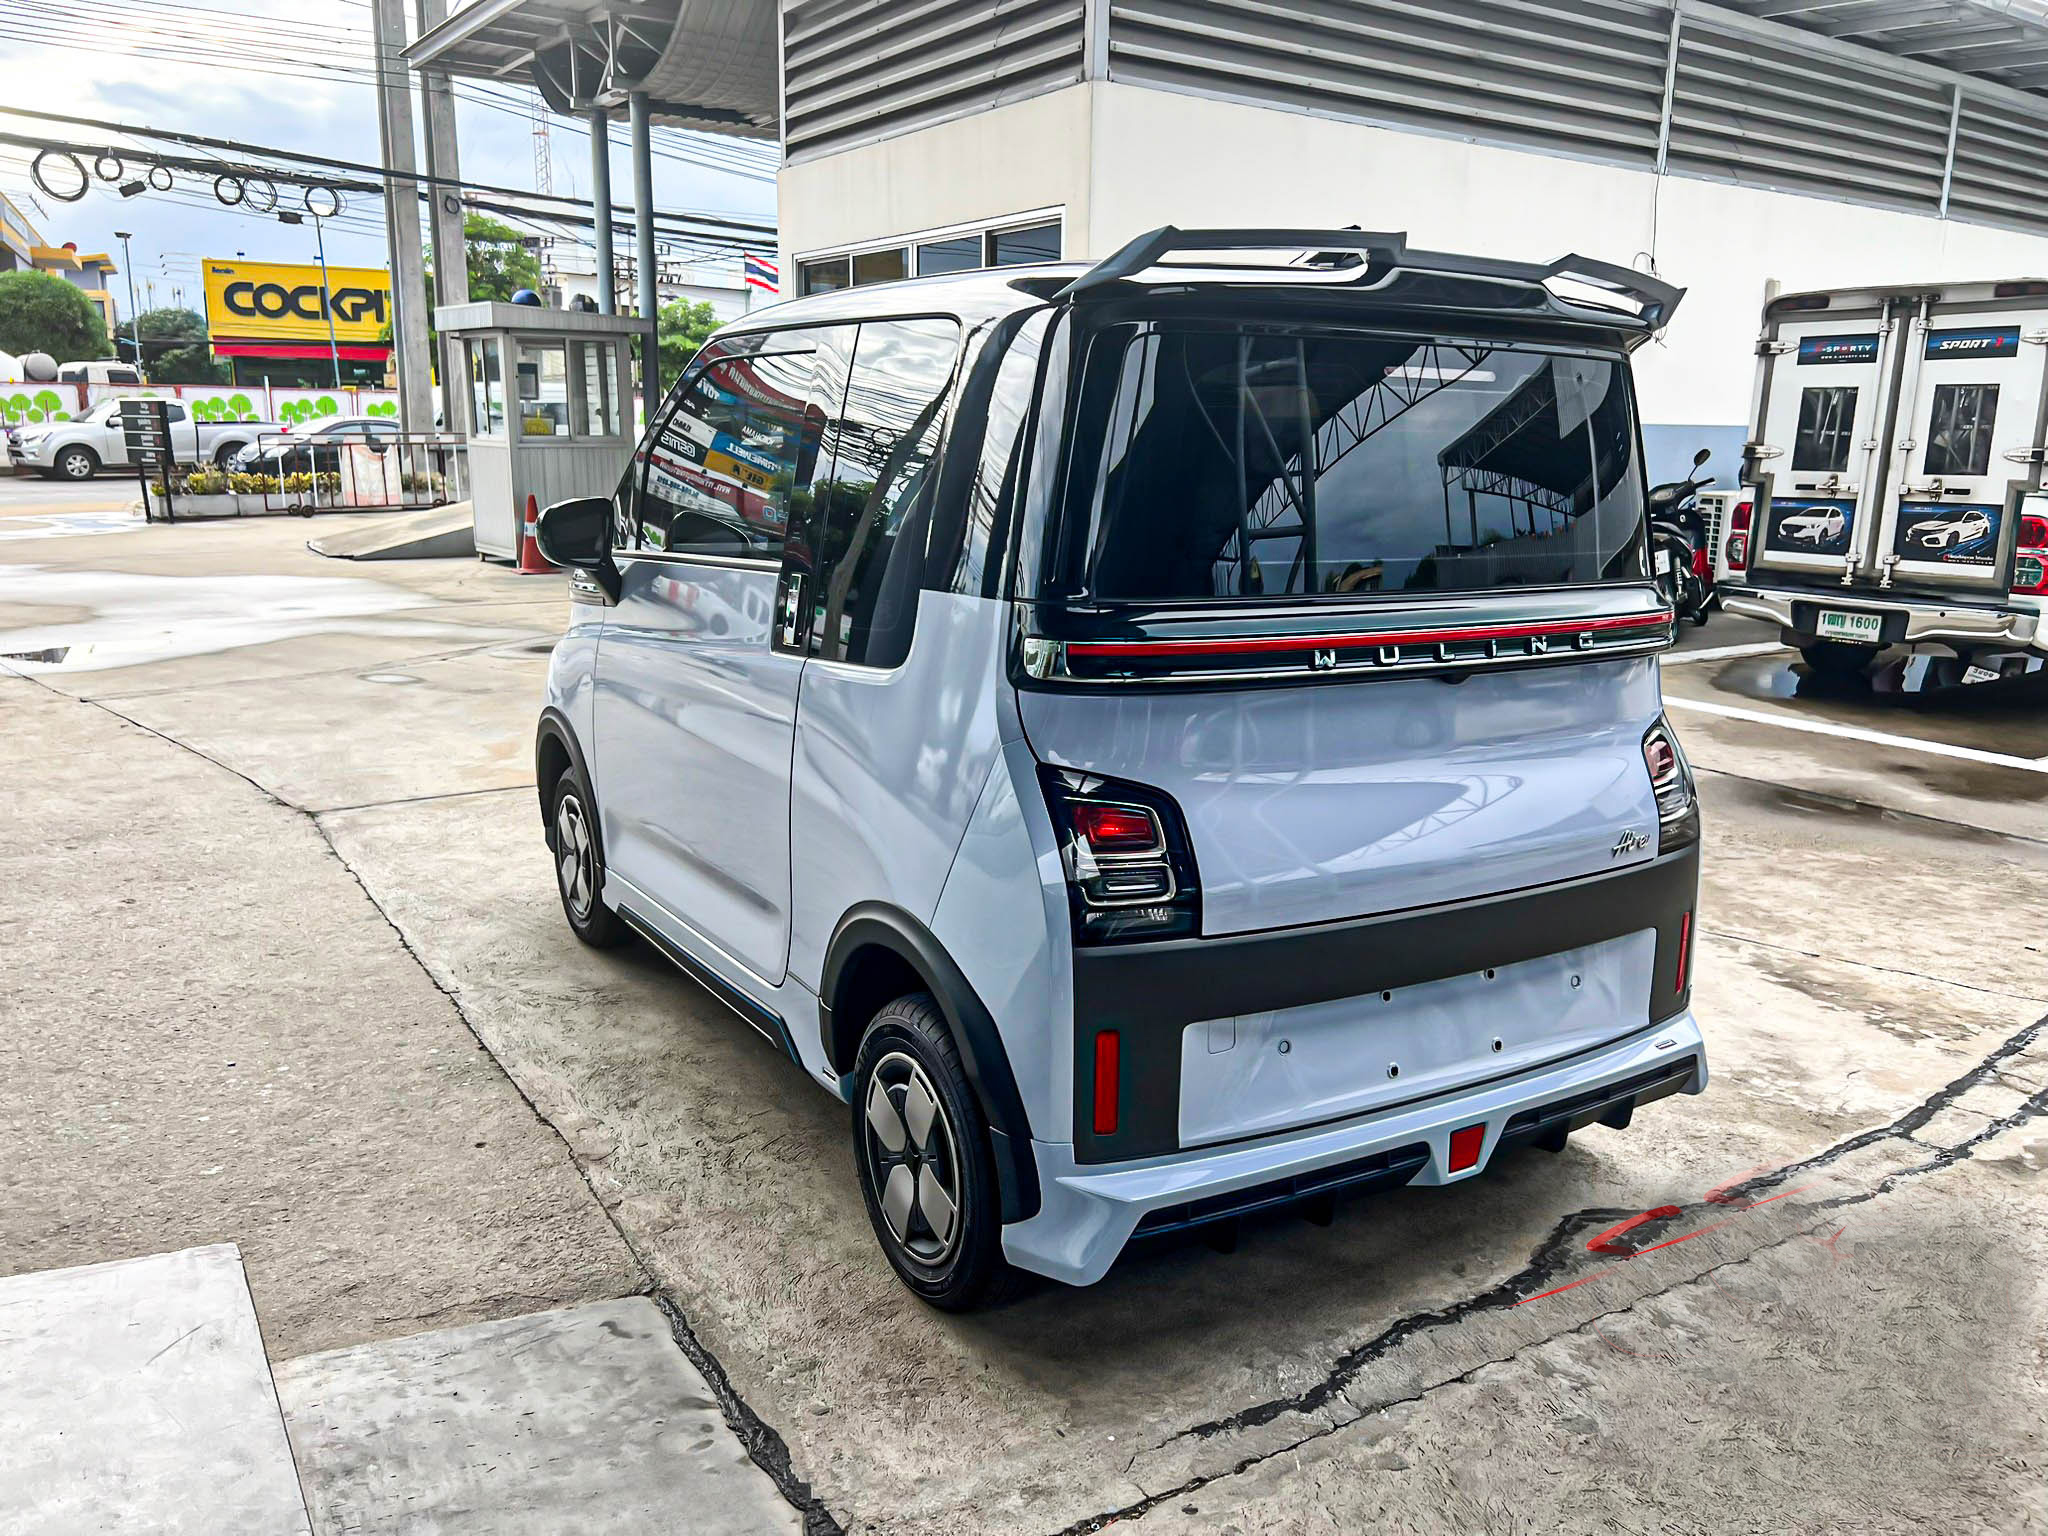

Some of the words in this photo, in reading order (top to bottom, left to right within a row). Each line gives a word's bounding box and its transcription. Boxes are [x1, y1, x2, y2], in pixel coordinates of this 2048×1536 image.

[223, 281, 389, 323] COCKPI
[1939, 338, 1992, 350] SPORT
[1850, 616, 1879, 630] 1600
[1313, 631, 1595, 669] WULING
